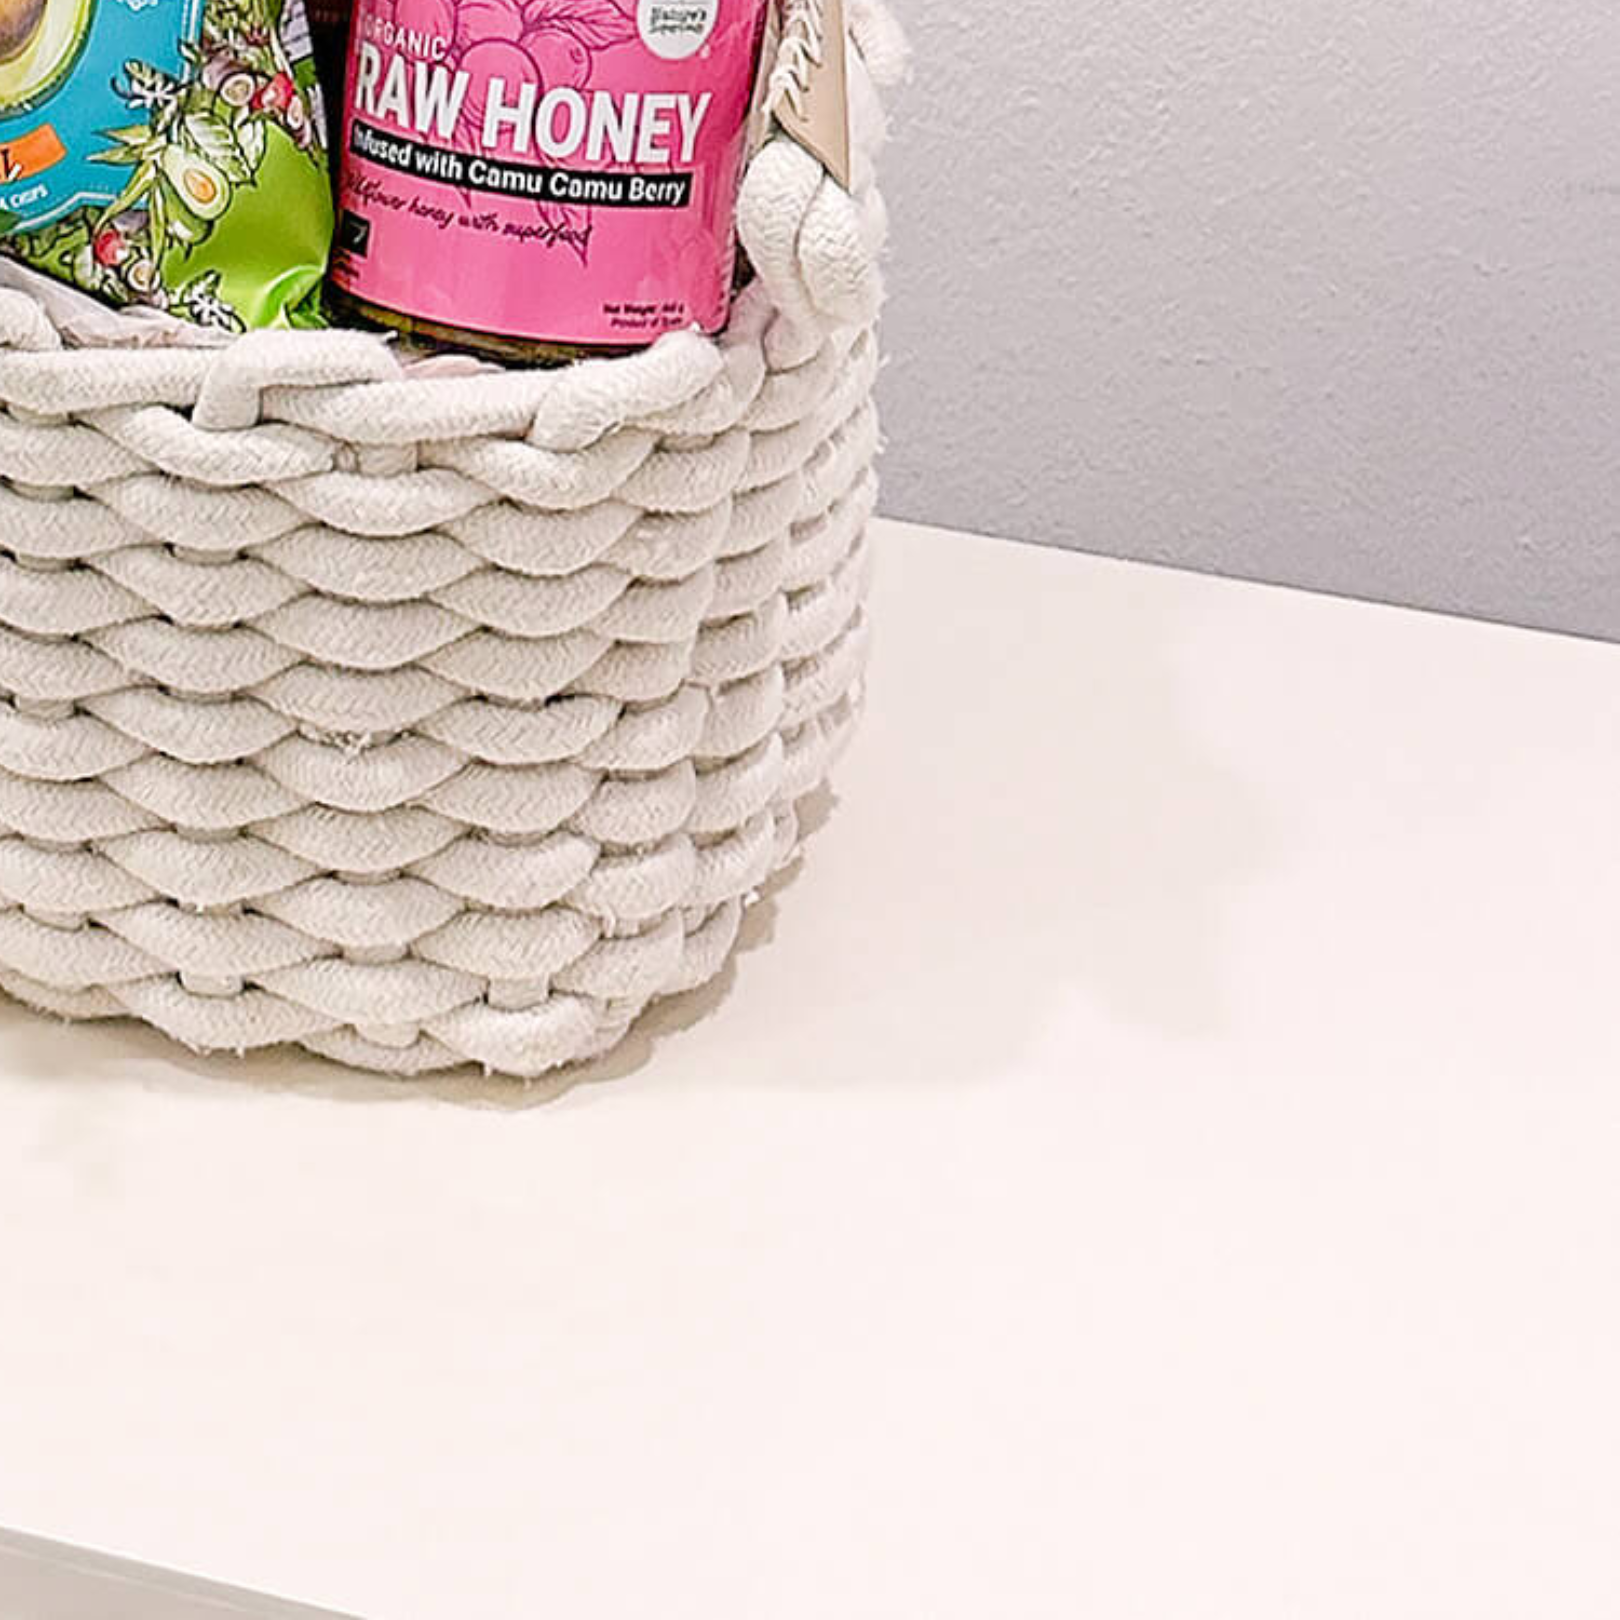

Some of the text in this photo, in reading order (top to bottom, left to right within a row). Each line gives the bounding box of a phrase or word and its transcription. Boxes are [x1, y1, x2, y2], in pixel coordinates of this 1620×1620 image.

[365, 14, 447, 61] ORGANIC
[355, 40, 713, 164] RAW HONEY
[353, 123, 686, 207] Infused with Camu Camu Berry
